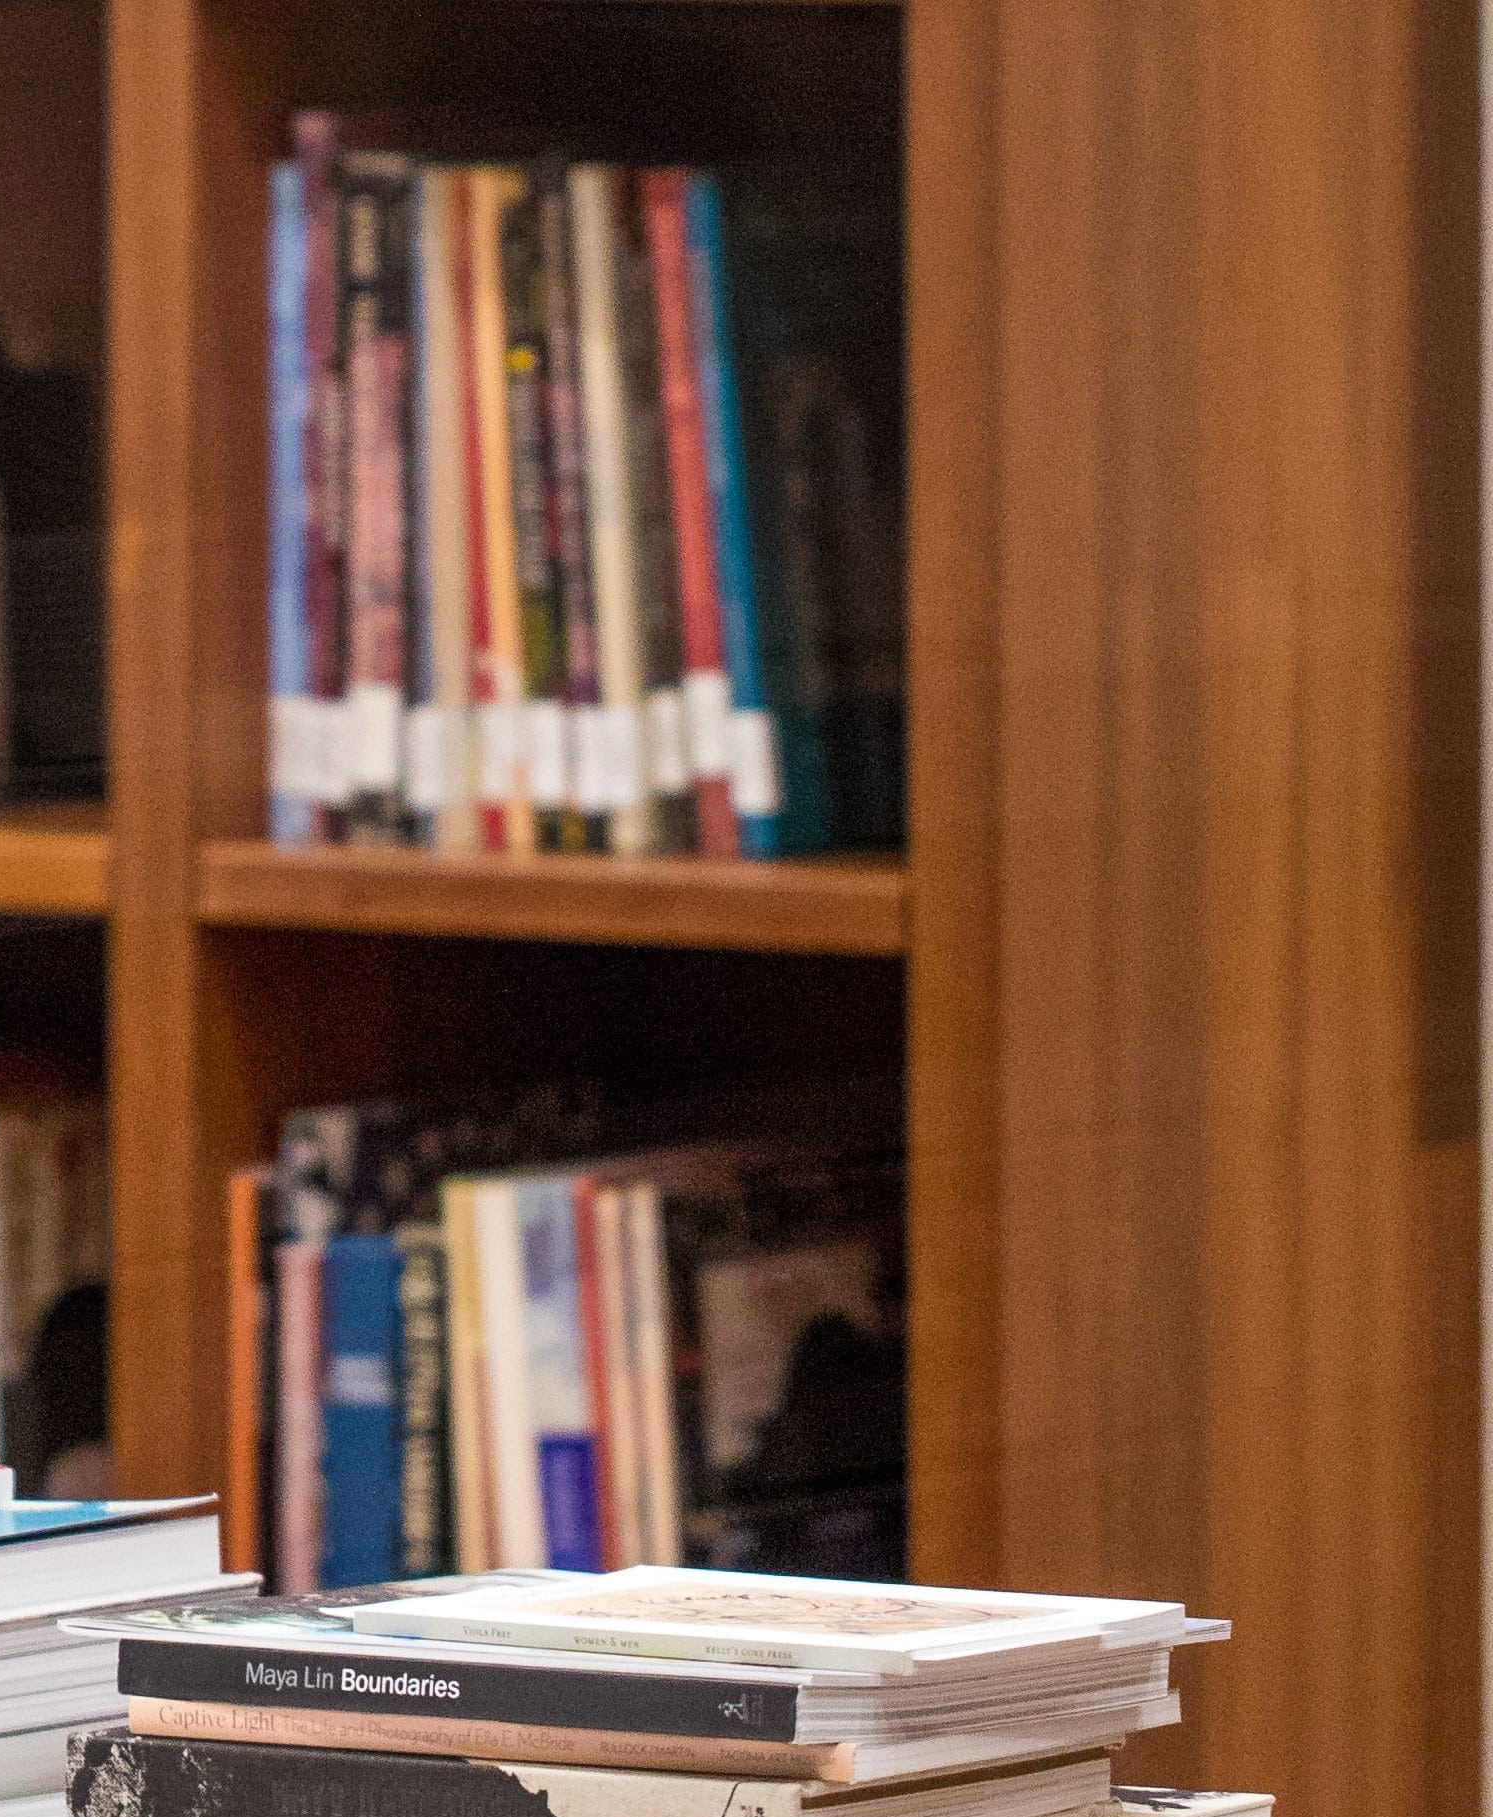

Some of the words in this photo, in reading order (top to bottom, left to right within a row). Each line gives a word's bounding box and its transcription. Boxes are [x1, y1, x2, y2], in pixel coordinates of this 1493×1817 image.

[574, 1636, 606, 1646] WOMEN
[620, 1639, 639, 1649] MEN
[245, 1662, 298, 1691] Maya
[304, 1666, 334, 1690] Lin
[341, 1668, 461, 1699] Boundaries
[159, 1704, 226, 1728] Captive
[231, 1708, 275, 1733] Light
[367, 1720, 454, 1748] Photography
